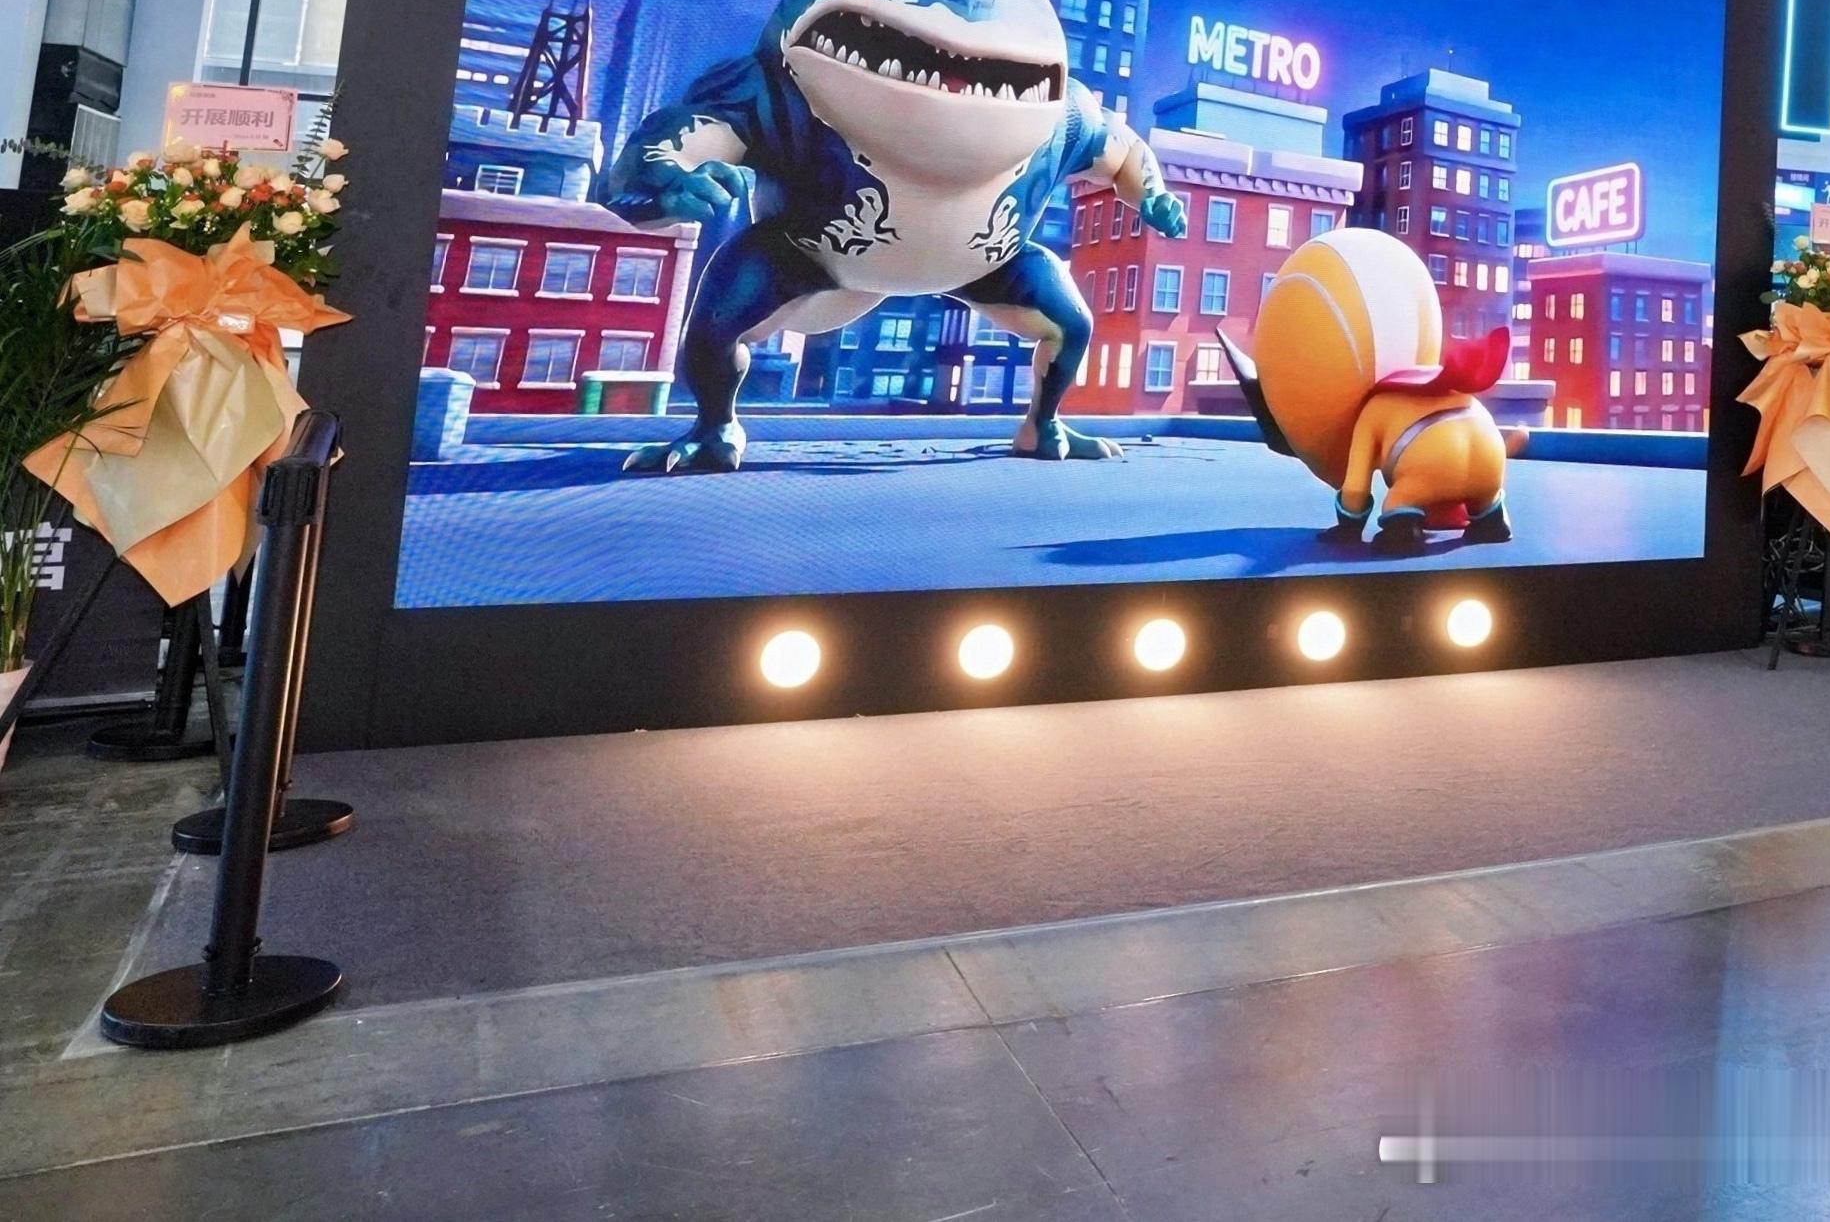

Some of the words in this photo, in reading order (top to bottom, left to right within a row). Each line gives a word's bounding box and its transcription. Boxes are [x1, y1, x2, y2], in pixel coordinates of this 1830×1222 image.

[1187, 14, 1322, 91] METRO
[181, 108, 275, 128] 开展顺利
[1555, 177, 1629, 233] CAFE
